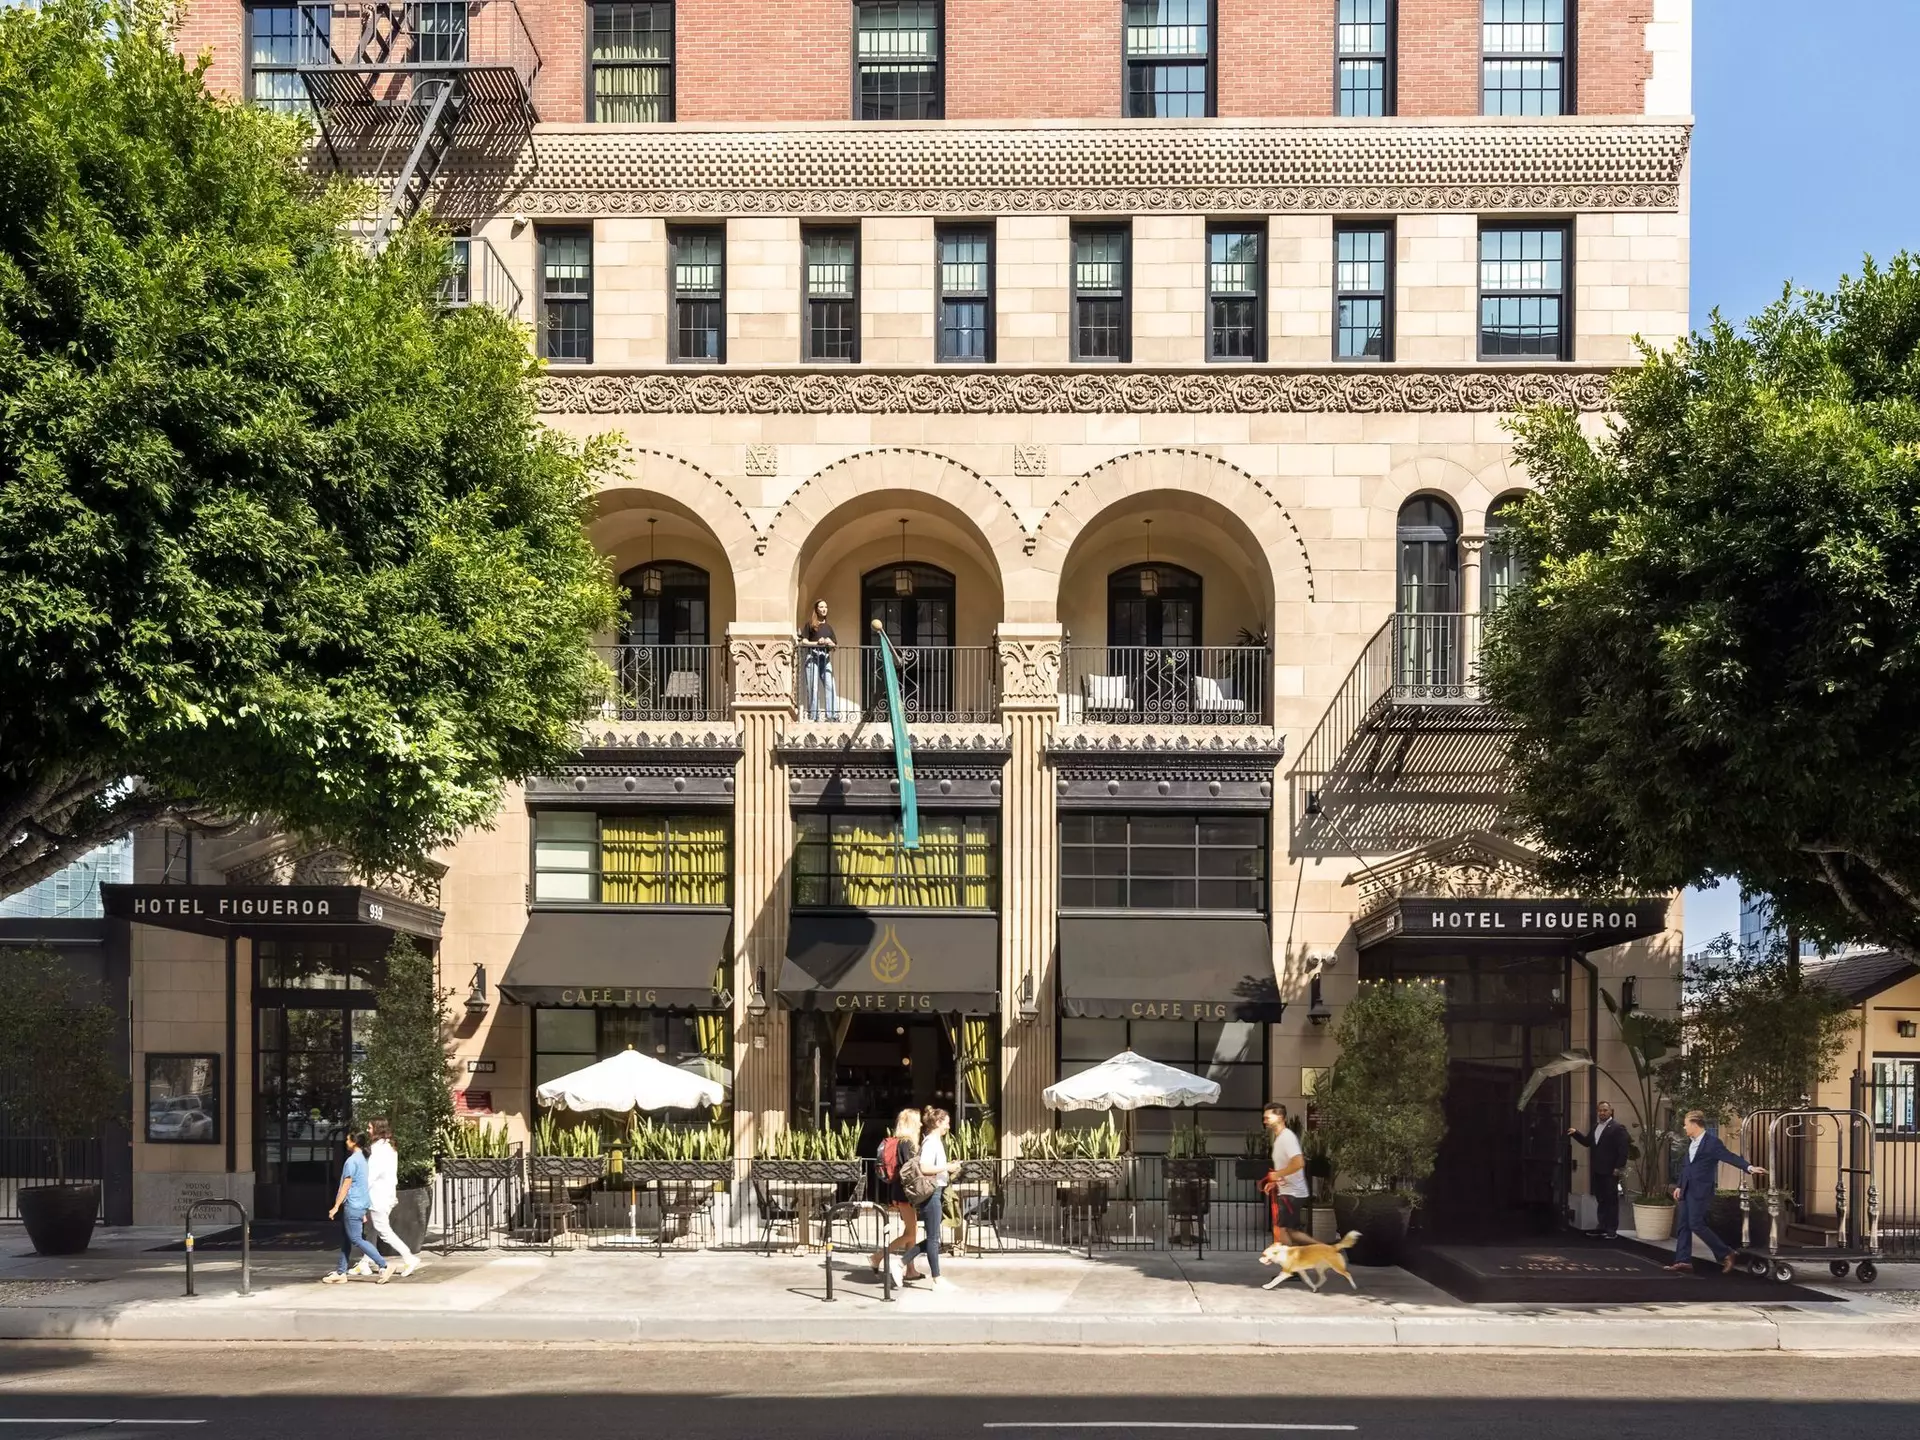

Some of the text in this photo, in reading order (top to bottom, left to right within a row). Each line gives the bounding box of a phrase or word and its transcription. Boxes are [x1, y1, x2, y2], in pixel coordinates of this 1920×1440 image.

[134, 898, 330, 916] HOTEL FIGUEROA
[369, 903, 383, 920] 939
[1431, 911, 1638, 929] HOTEL FIGUEROA
[624, 989, 657, 1003] FIG
[835, 995, 931, 1008] CAFE FIG
[1131, 1002, 1226, 1018] CAFE FIG
